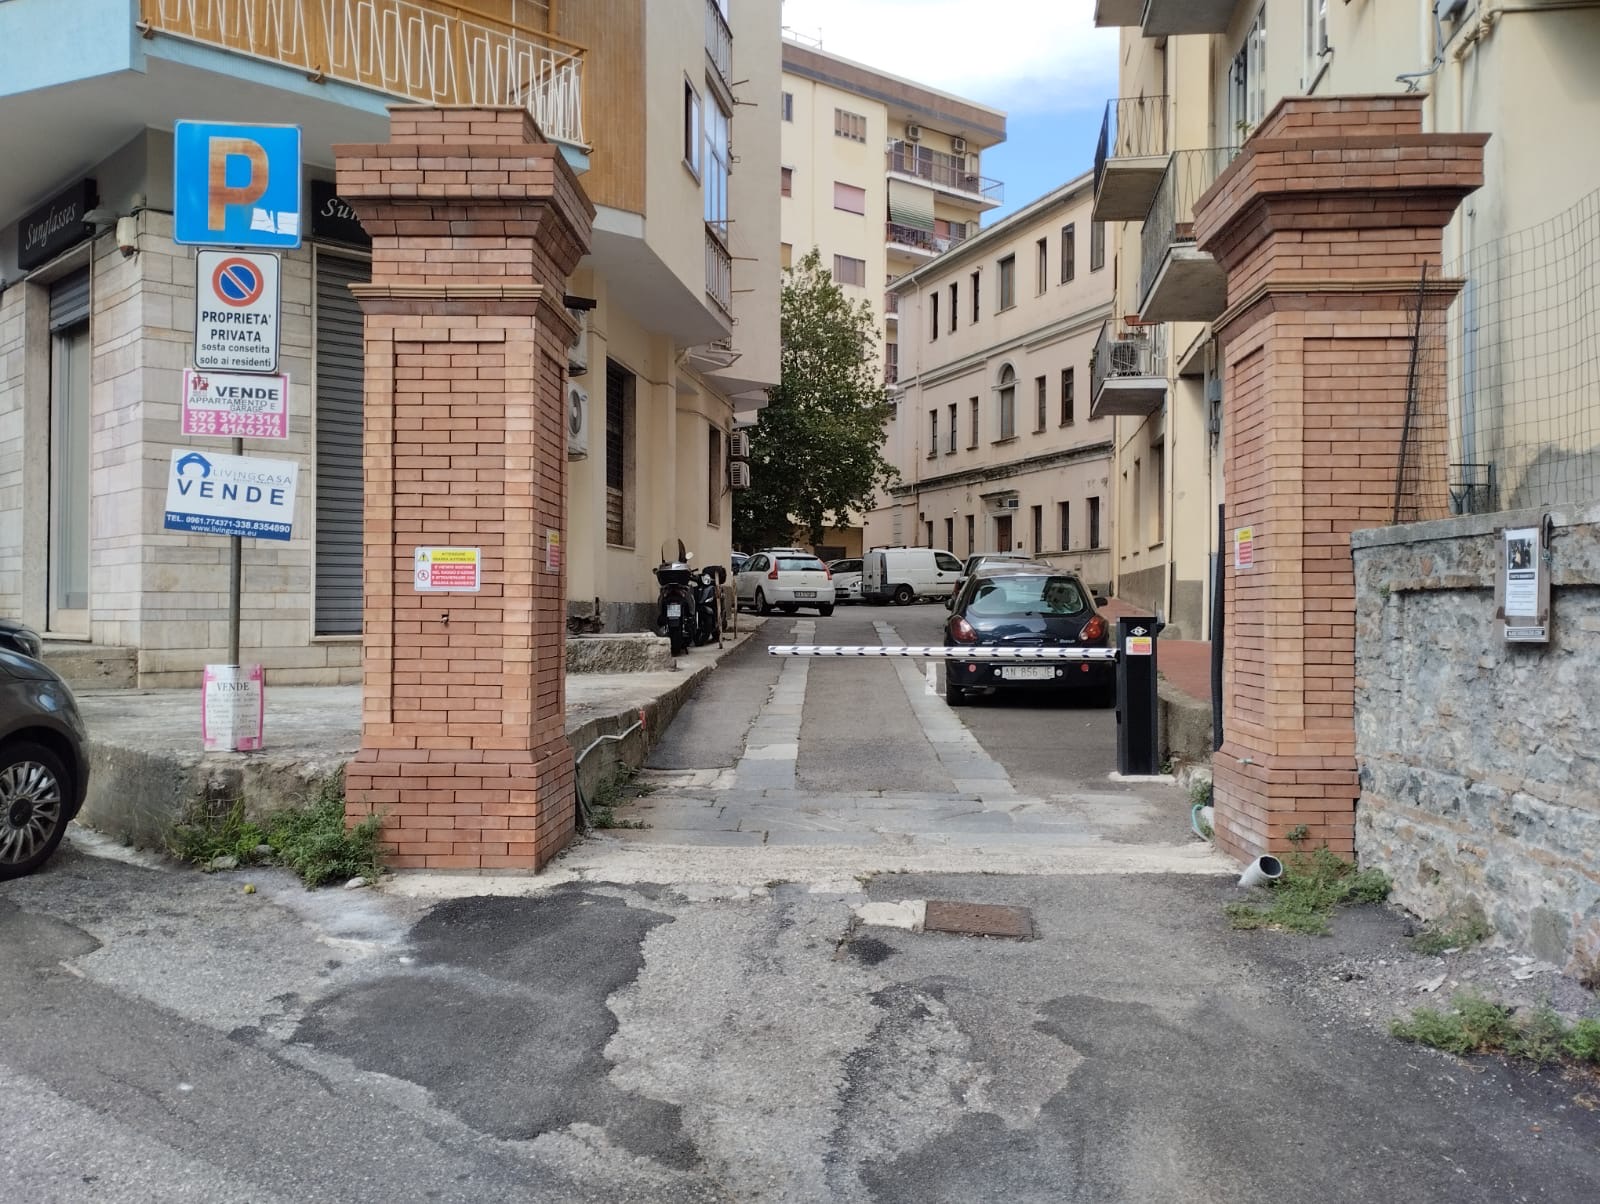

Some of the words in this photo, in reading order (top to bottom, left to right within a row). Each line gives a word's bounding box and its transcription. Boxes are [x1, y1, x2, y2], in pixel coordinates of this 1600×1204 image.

[208, 136, 269, 231] P
[25, 203, 76, 250] Sunglasses
[202, 311, 271, 325] PROPRIETA'
[210, 329, 262, 342] PRIVATA
[201, 342, 226, 352] sosta
[228, 344, 270, 354] consetita
[200, 355, 218, 365] solo
[221, 356, 229, 365] ai
[231, 357, 271, 367] residenti
[215, 386, 279, 401] VENDE
[189, 396, 267, 408] APPARTAMENTO
[270, 402, 276, 410] E
[189, 411, 216, 422] 392
[189, 422, 216, 433] 329
[177, 478, 285, 506] VENDE
[167, 514, 184, 522] TEL.
[191, 525, 257, 537] www.livingcasa.eu
[217, 682, 250, 691] VENDE
